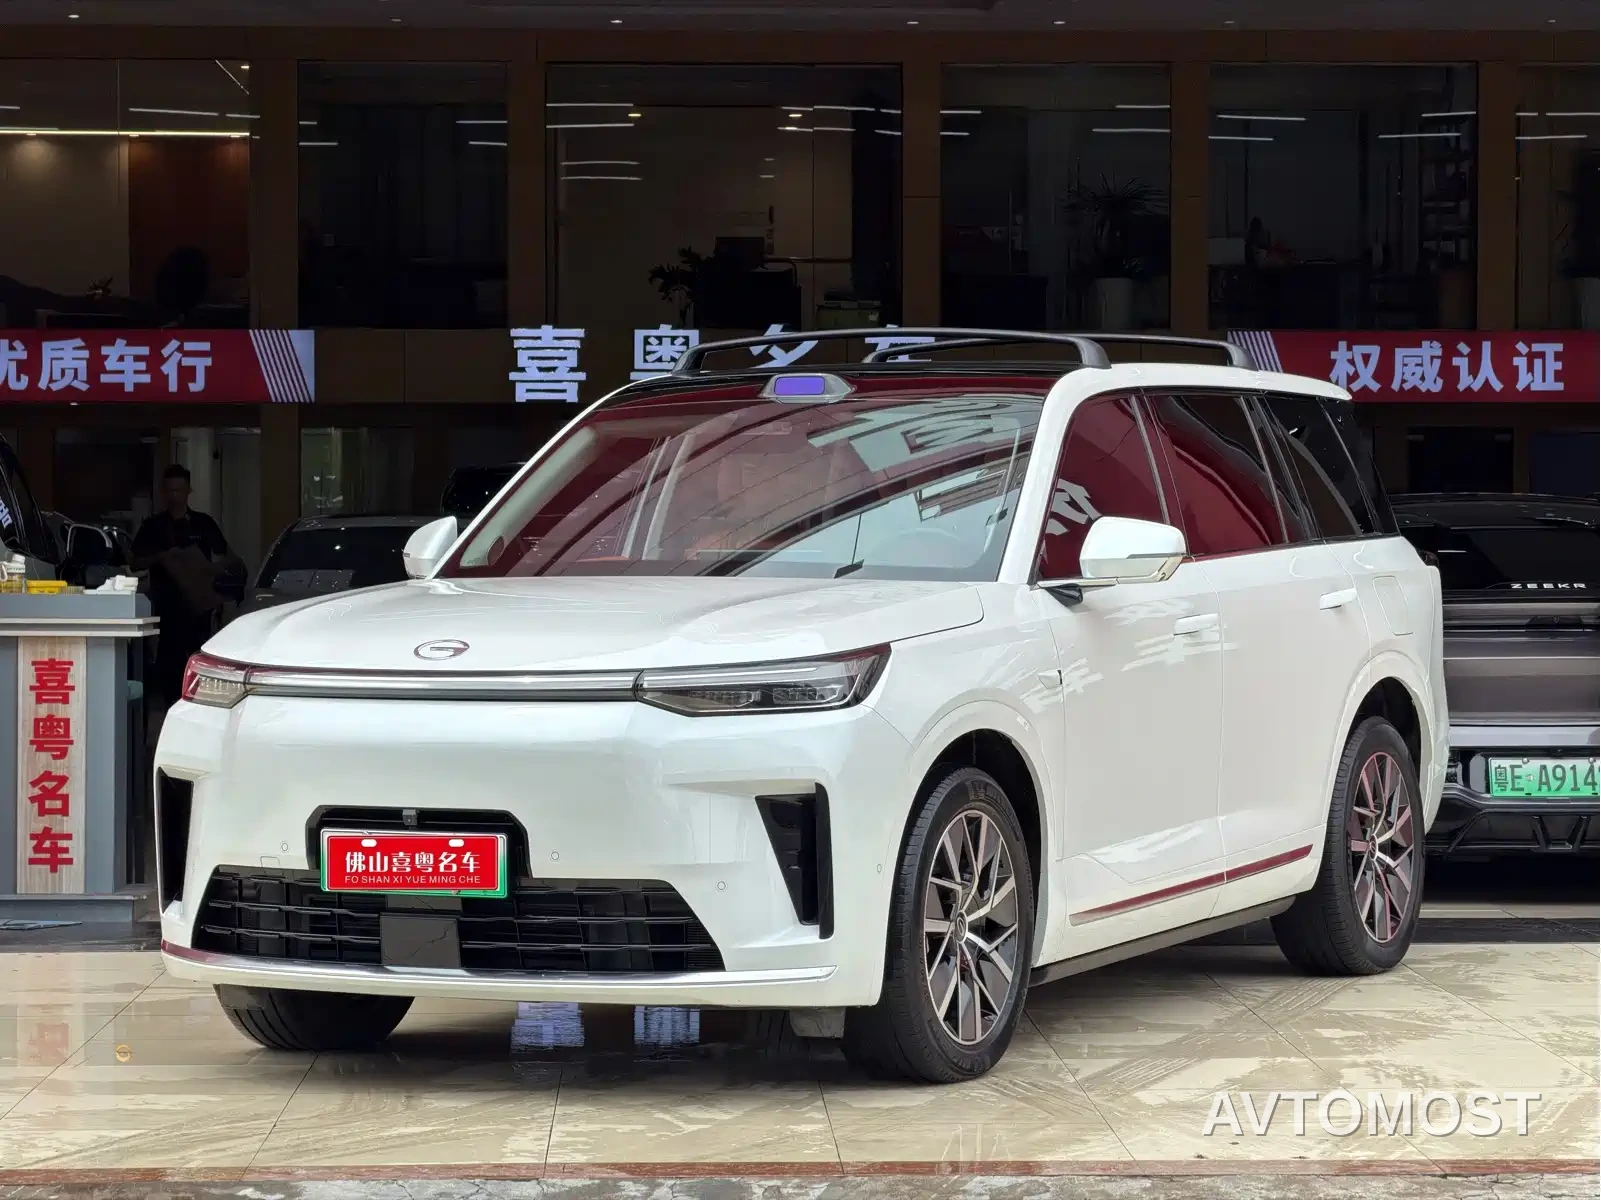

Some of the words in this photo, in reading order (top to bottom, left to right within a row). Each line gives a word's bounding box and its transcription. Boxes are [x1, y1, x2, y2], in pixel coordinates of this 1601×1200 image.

[1329, 340, 1565, 393] 权威认证
[28, 658, 76, 873] 喜粤名车
[345, 851, 481, 873] 佛山喜粤名车
[345, 875, 359, 884] FO
[361, 875, 390, 884] SHAN
[393, 875, 403, 884] XI
[405, 875, 427, 884] YUE
[429, 875, 457, 884] MING
[458, 875, 481, 884] CHE
